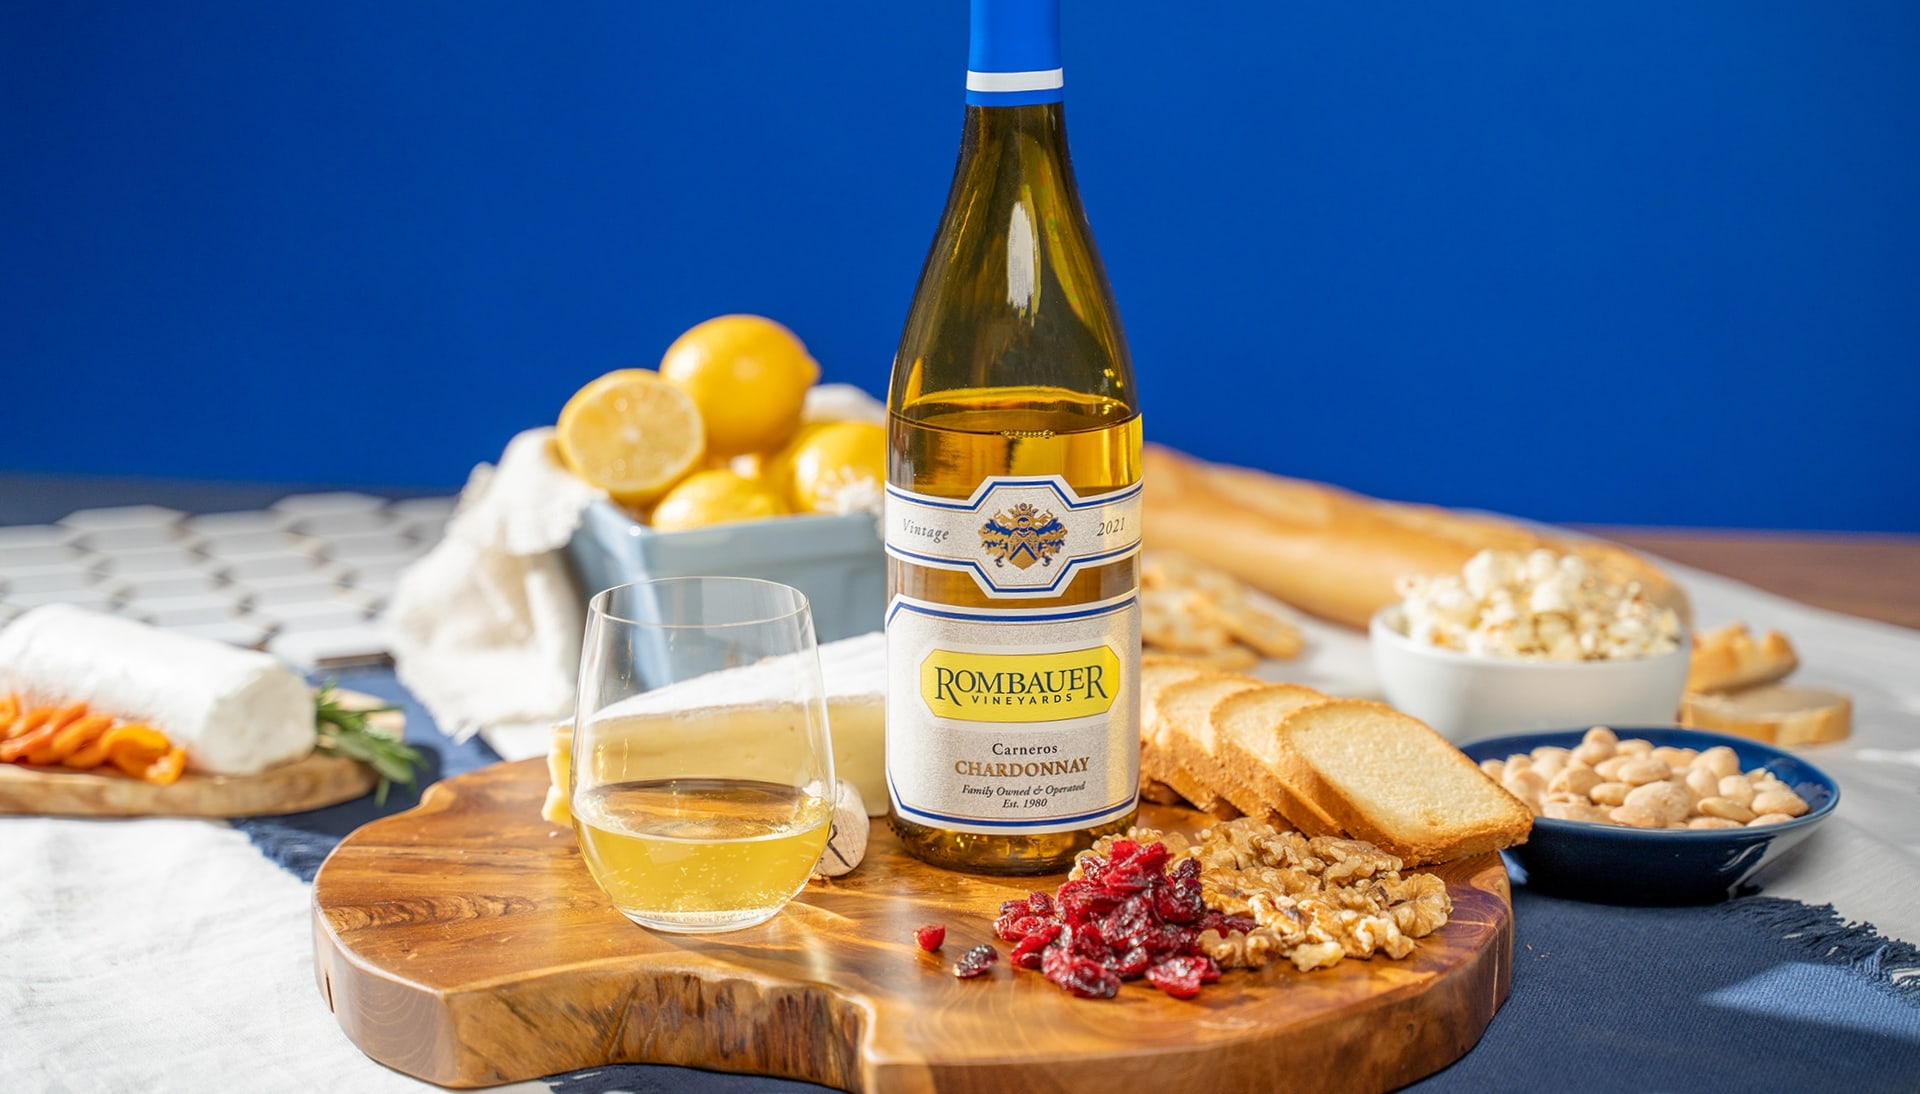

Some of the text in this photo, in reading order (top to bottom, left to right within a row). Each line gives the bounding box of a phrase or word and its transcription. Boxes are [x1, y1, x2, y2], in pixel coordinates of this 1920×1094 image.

[903, 517, 1126, 544] Vintage 2021
[934, 664, 1109, 707] ROMBAUER
[971, 693, 1072, 705] VINEYARDS
[992, 743, 1058, 756] Carneros
[954, 757, 1090, 777] CHARDONNAY
[961, 780, 1086, 798] Family Owned & Operated
[1002, 798, 1048, 809] Est. 1980
